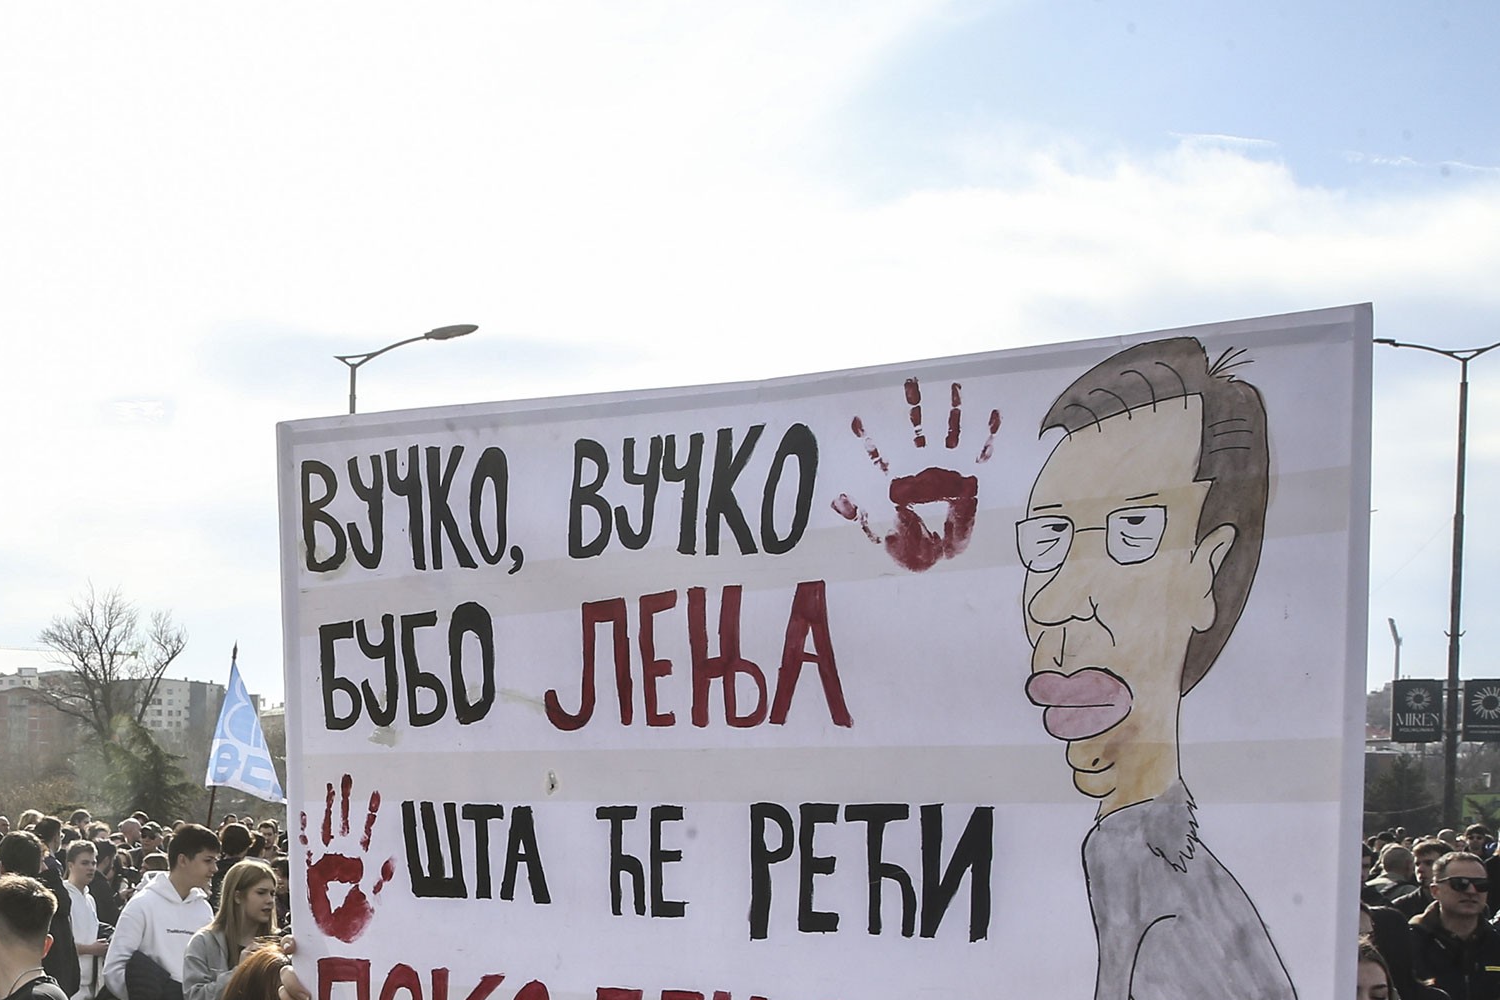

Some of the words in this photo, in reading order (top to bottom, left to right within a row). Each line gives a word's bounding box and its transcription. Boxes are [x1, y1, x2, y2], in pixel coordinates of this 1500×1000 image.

[300, 443, 523, 575] ВУЧКО,
[568, 423, 820, 559] ВУЧКО
[319, 601, 495, 731] БУБО
[544, 579, 853, 730] ЛЕЊА
[401, 802, 551, 904] ШТА
[597, 803, 690, 919] ЋЕ
[748, 801, 996, 943] РЕЋИ
